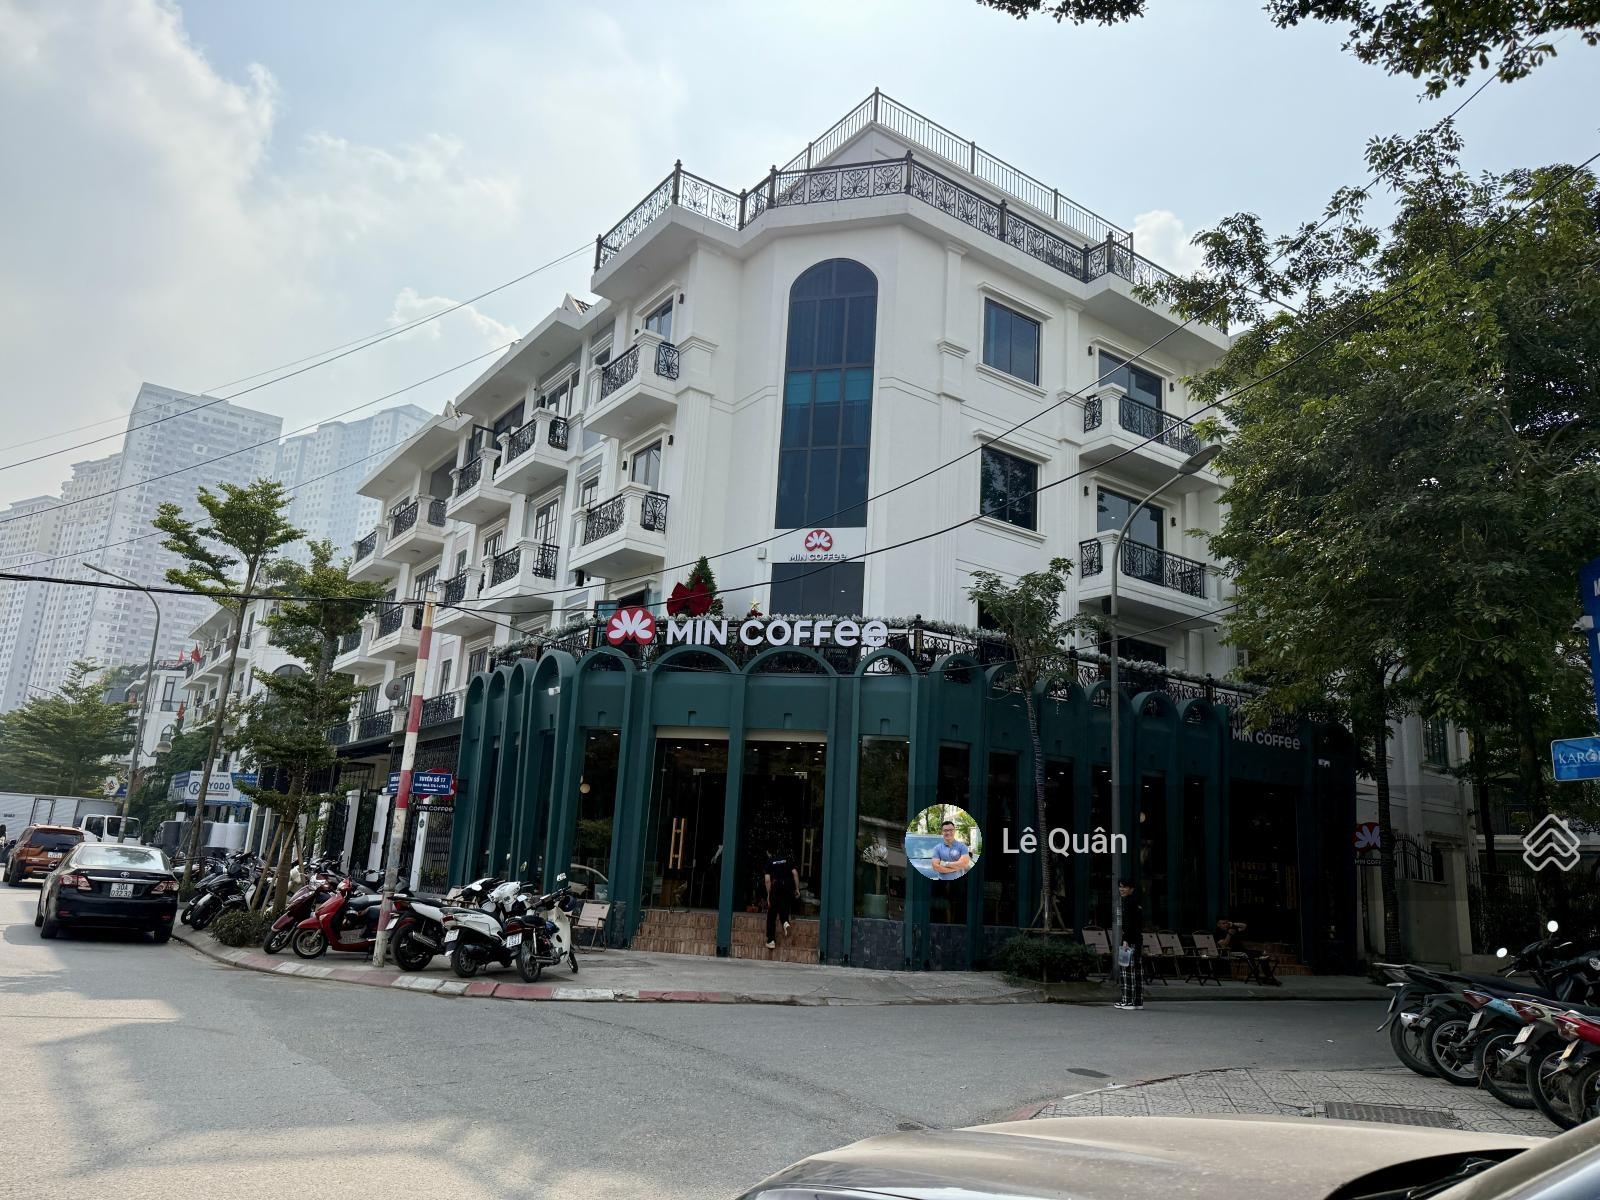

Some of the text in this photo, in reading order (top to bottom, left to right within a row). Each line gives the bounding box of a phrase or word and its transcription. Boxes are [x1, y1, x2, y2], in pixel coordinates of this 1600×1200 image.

[789, 554, 808, 562] MIN
[666, 619, 889, 647] MIN COFFee
[1232, 727, 1301, 750] MIN COFFee
[433, 775, 441, 783] SỐ
